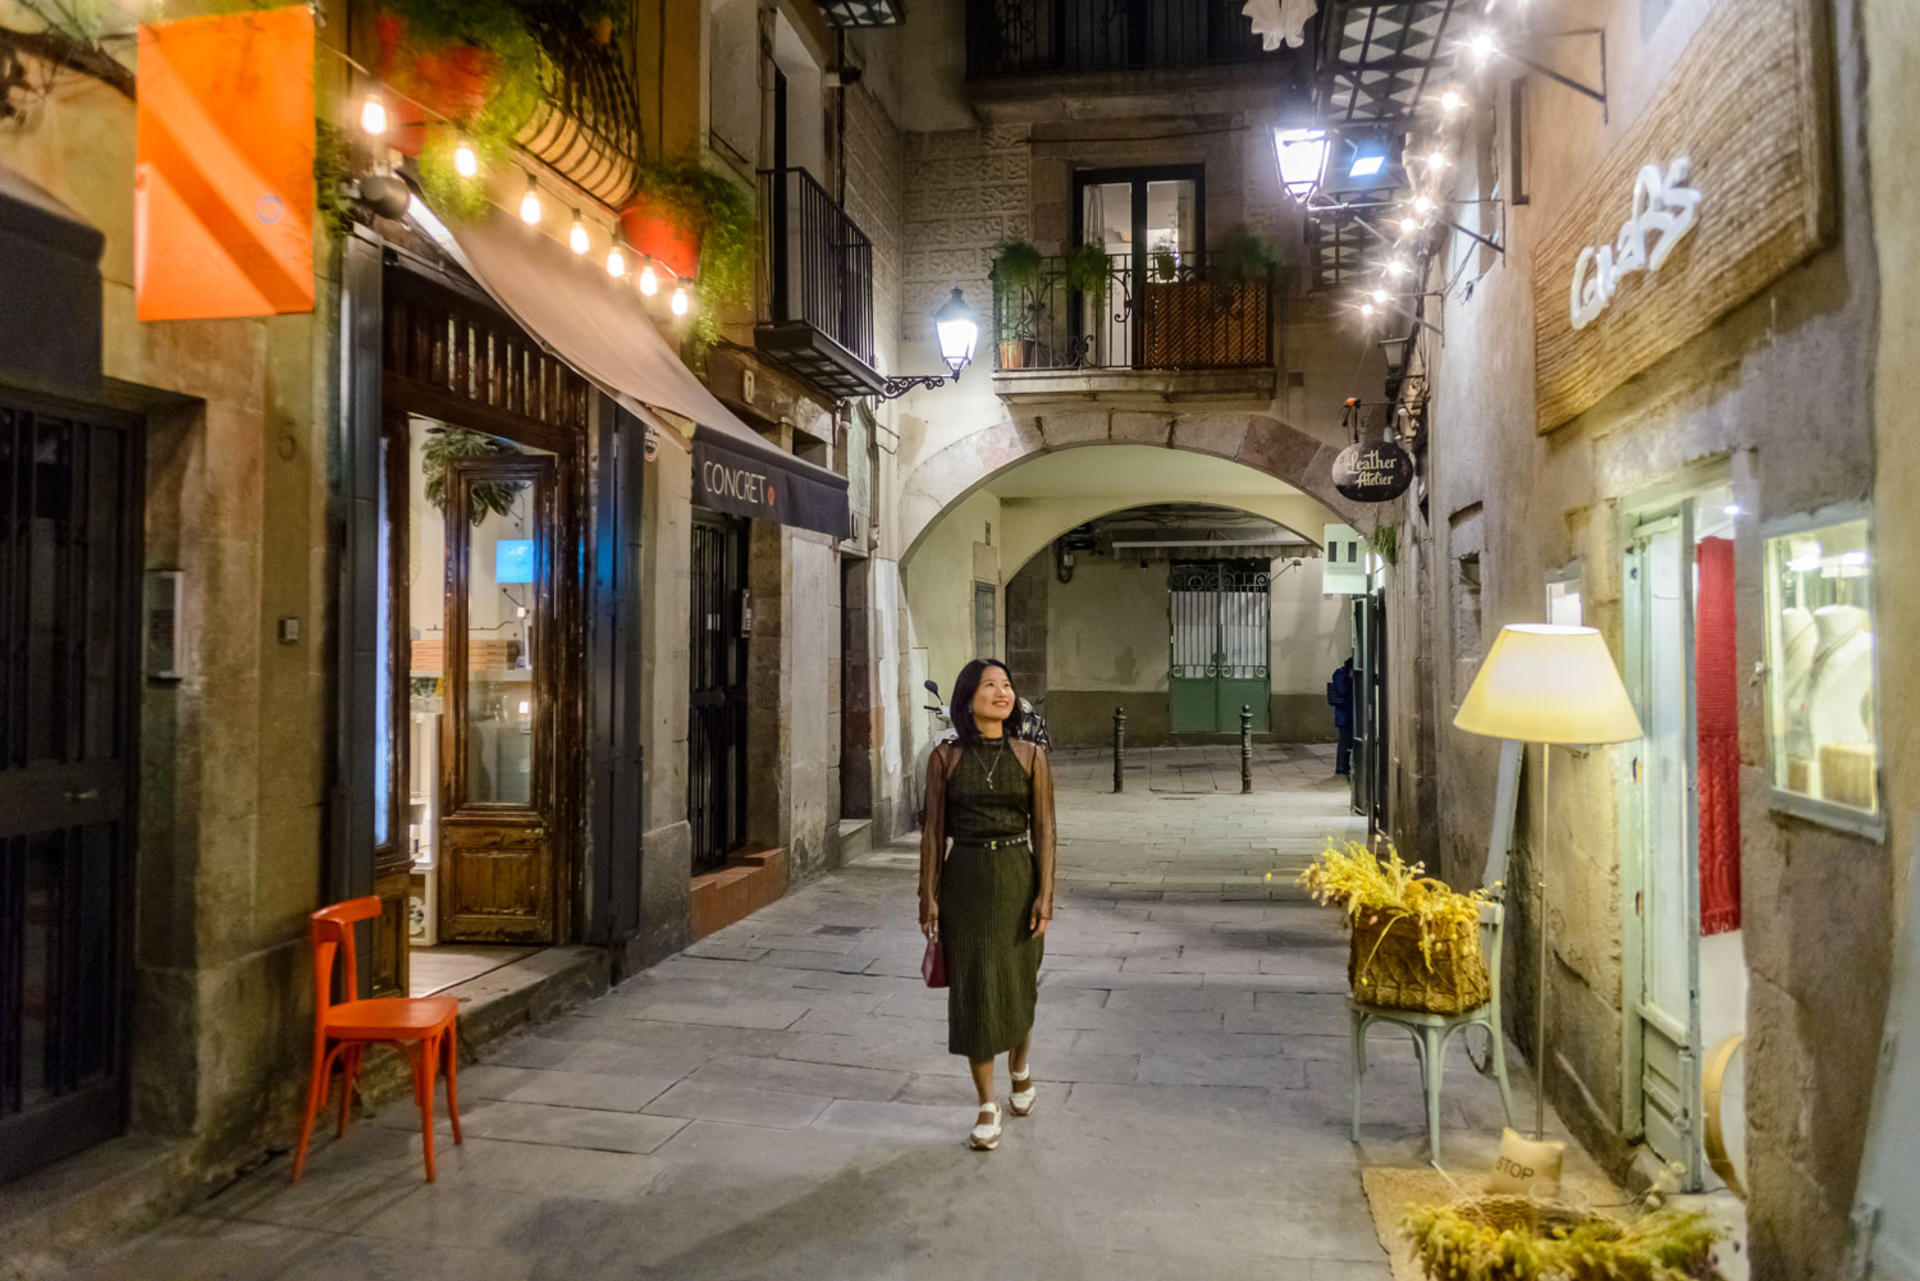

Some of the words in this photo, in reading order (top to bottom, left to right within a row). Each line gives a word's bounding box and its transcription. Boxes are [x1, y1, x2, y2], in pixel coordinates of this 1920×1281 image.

[1346, 449, 1396, 475] Leather
[704, 461, 766, 504] CONCRET
[1355, 471, 1394, 489] Atelier
[1496, 1156, 1534, 1180] STOP
